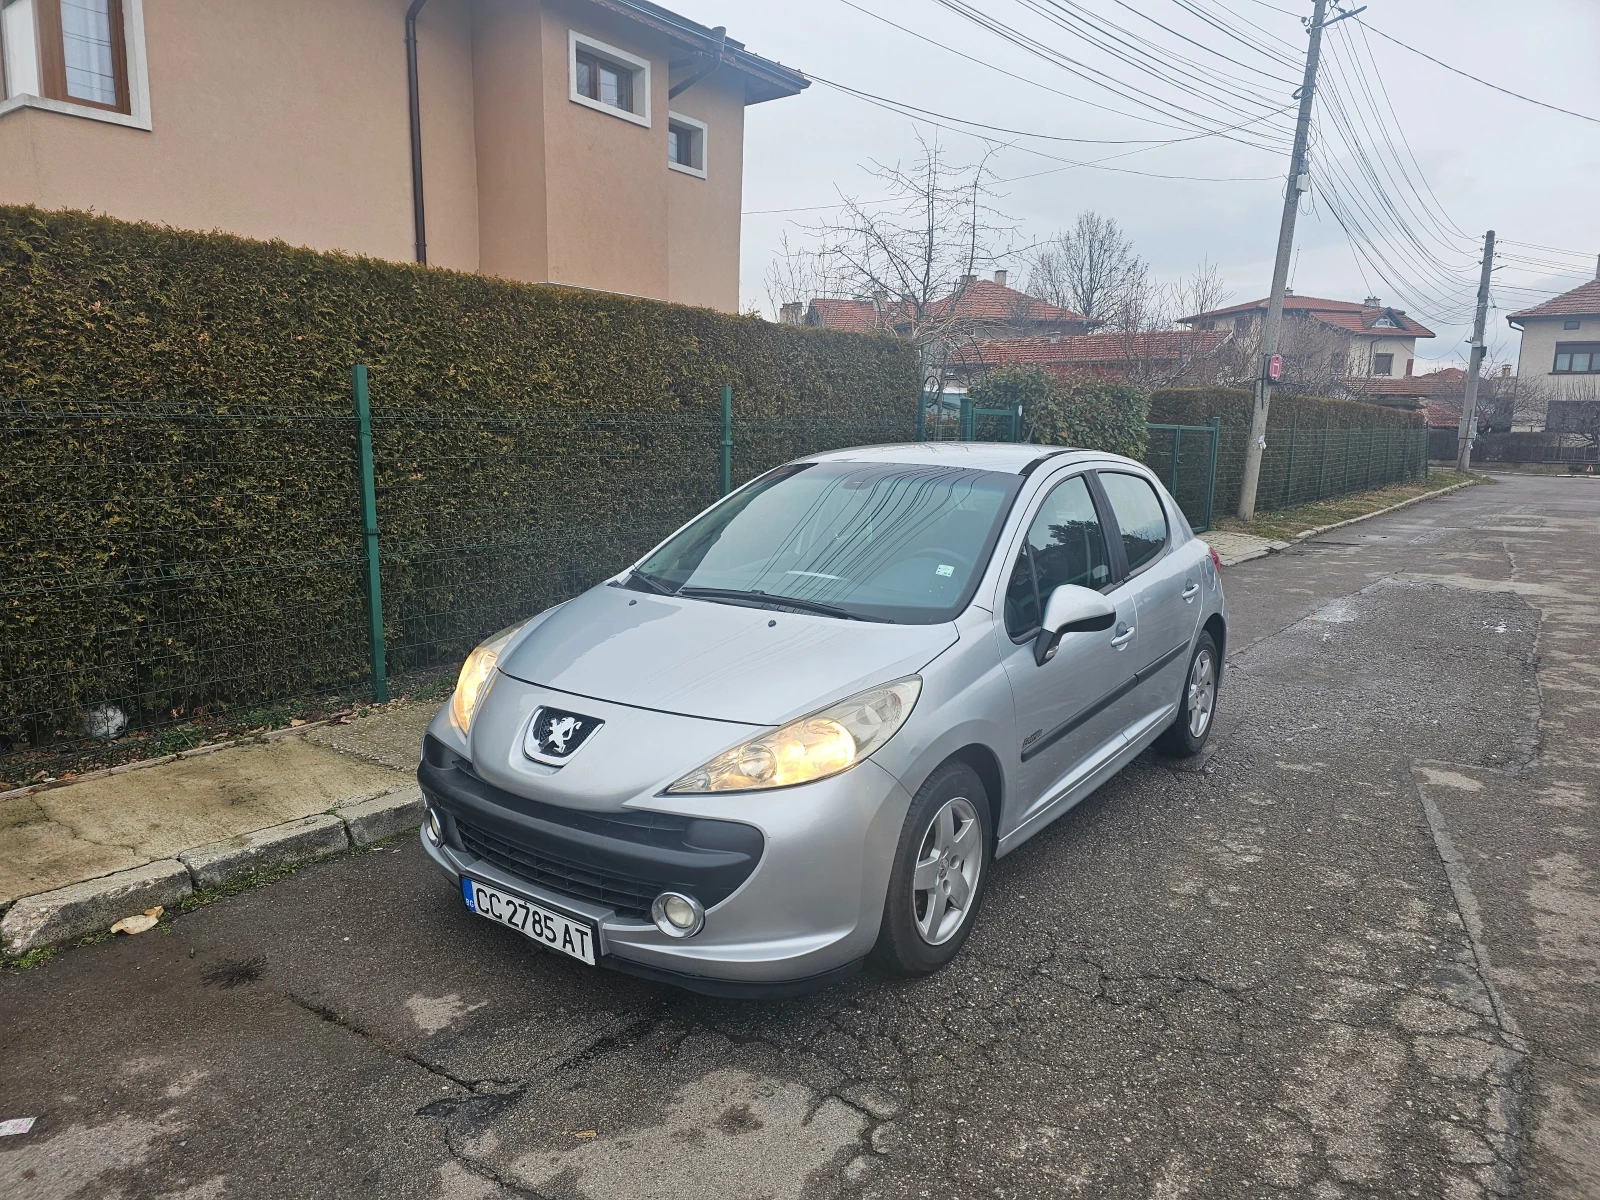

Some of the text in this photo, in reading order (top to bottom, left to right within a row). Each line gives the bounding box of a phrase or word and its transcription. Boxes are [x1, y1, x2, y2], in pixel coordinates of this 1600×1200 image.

[476, 888, 588, 957] CC 2785 AT
